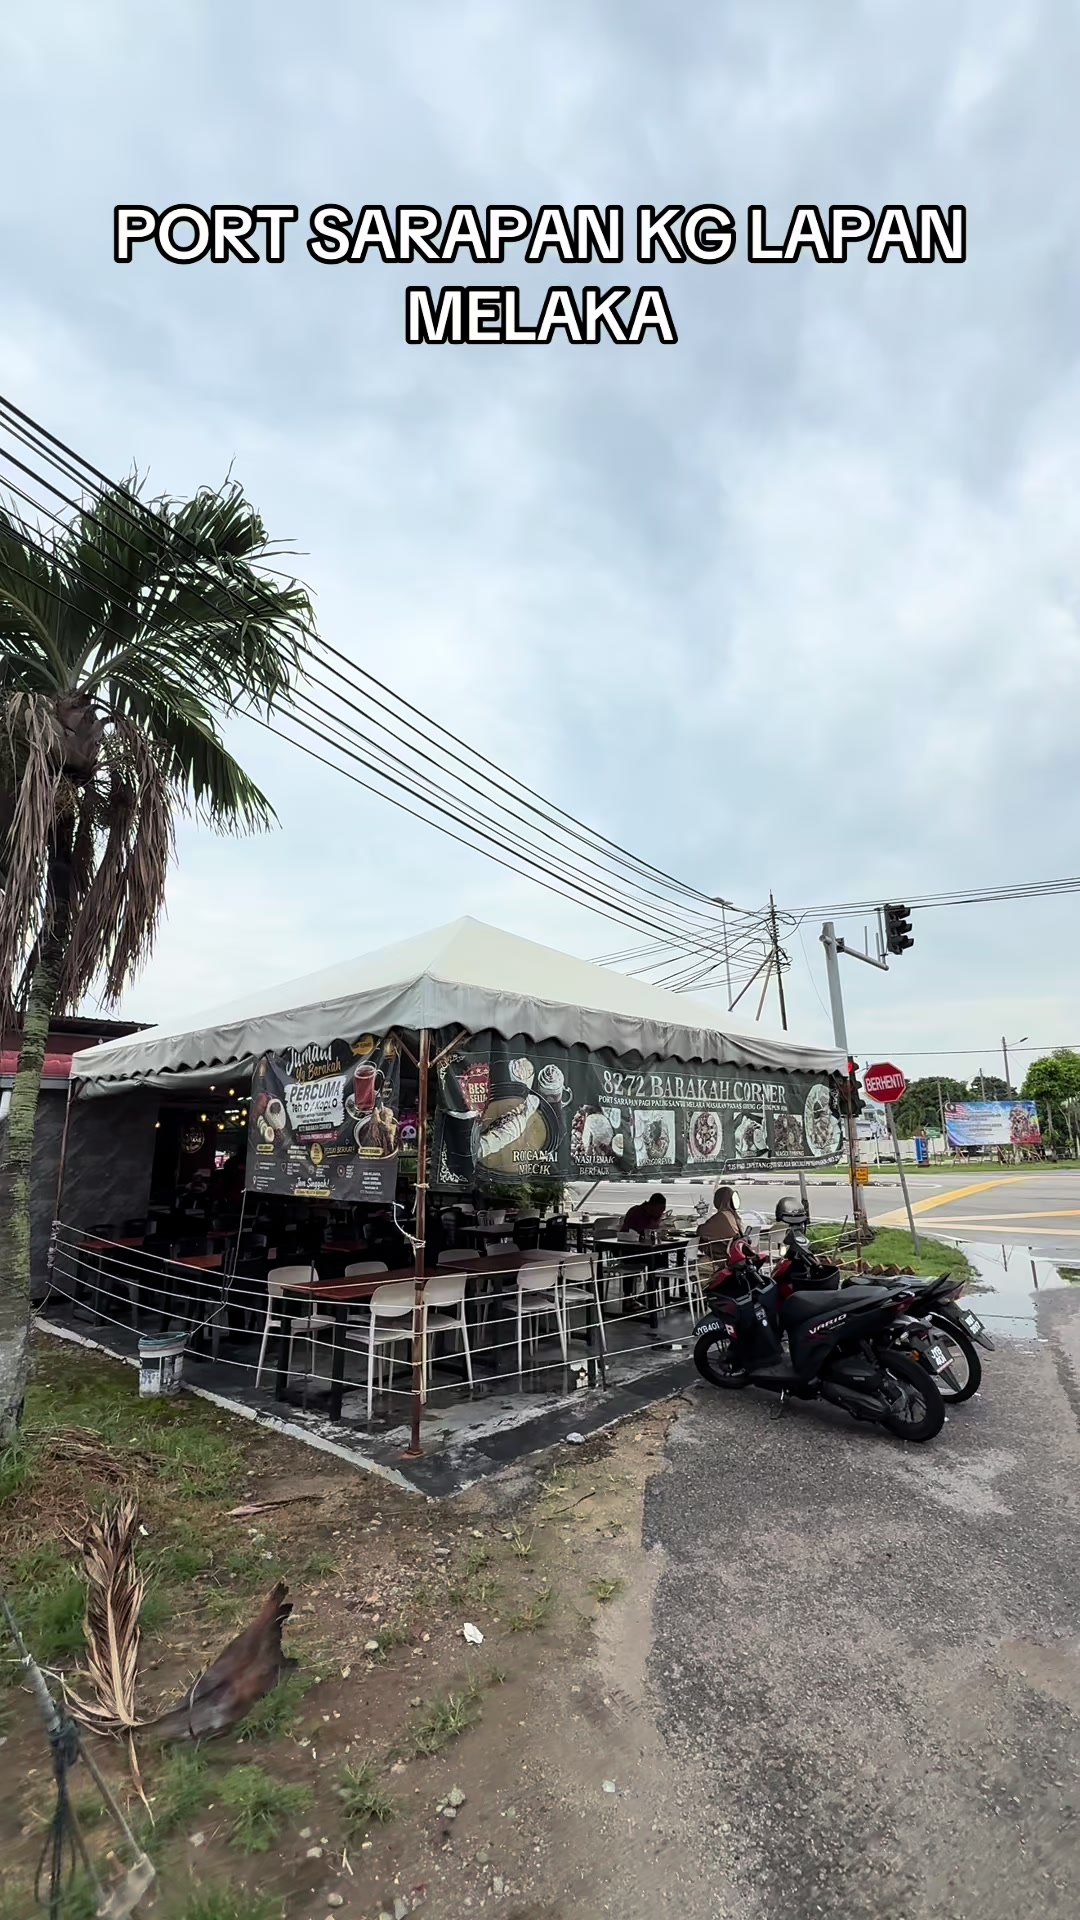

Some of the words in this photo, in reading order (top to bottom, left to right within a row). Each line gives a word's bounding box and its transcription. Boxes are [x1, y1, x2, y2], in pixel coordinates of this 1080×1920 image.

[307, 1056, 341, 1080] Barakah
[289, 1080, 340, 1102] PERCUMA
[603, 1070, 646, 1097] 8272
[650, 1075, 730, 1101] BARAKAH
[733, 1081, 786, 1104] CORNER
[864, 1073, 905, 1092] BERHENTI
[291, 1102, 302, 1112] Teh
[303, 1102, 310, 1111] O
[331, 1098, 338, 1108] O
[598, 1095, 613, 1104] PORT
[613, 1097, 638, 1107] SARAPAN
[638, 1099, 651, 1107] PAGI
[686, 1101, 705, 1109] MELAKA
[526, 1150, 558, 1162] CANAI
[575, 1155, 592, 1164] NASI
[592, 1155, 615, 1164] LEMAK
[808, 1313, 848, 1335] VARIO
